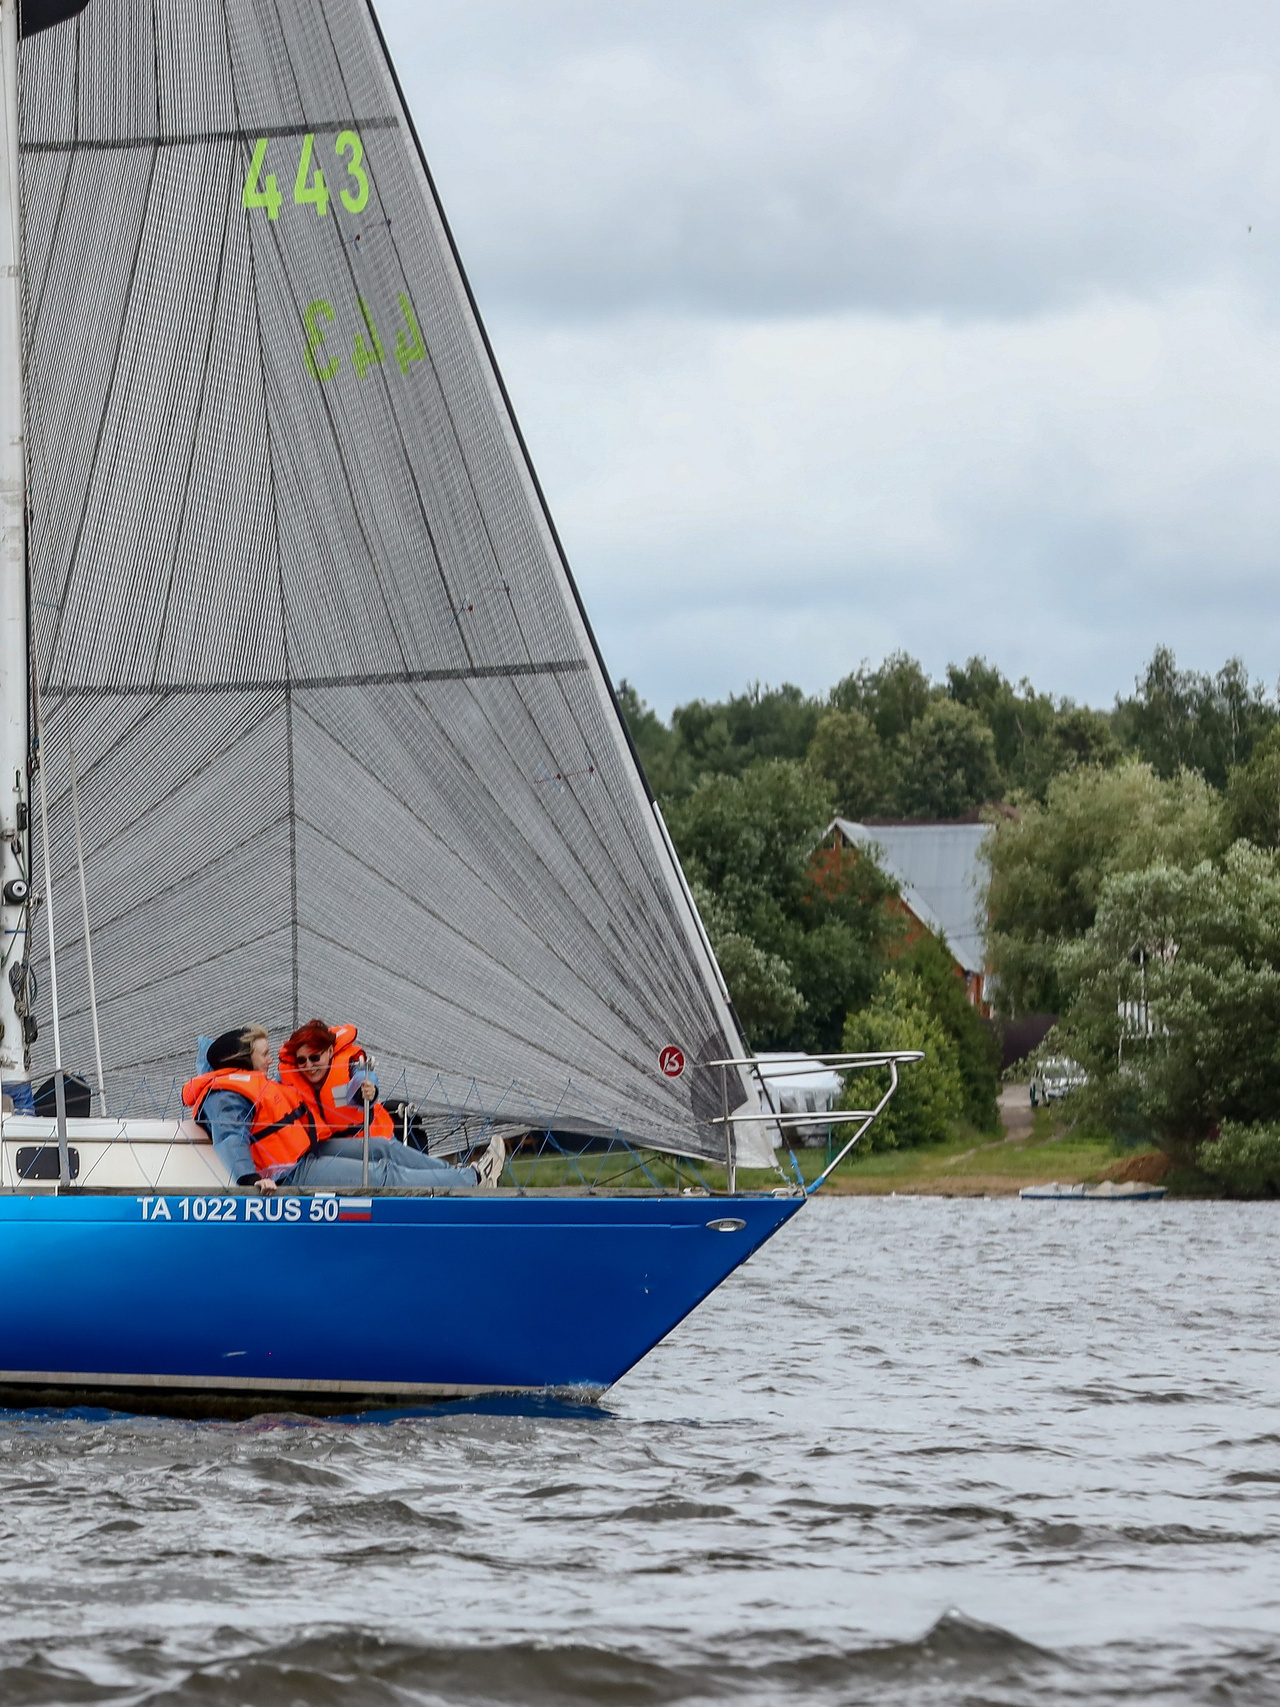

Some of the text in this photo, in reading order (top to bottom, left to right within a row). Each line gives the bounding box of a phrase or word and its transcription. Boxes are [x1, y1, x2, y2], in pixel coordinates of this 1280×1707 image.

[242, 130, 370, 220] 443
[137, 1196, 339, 1221] TA 1022 RUS 50
